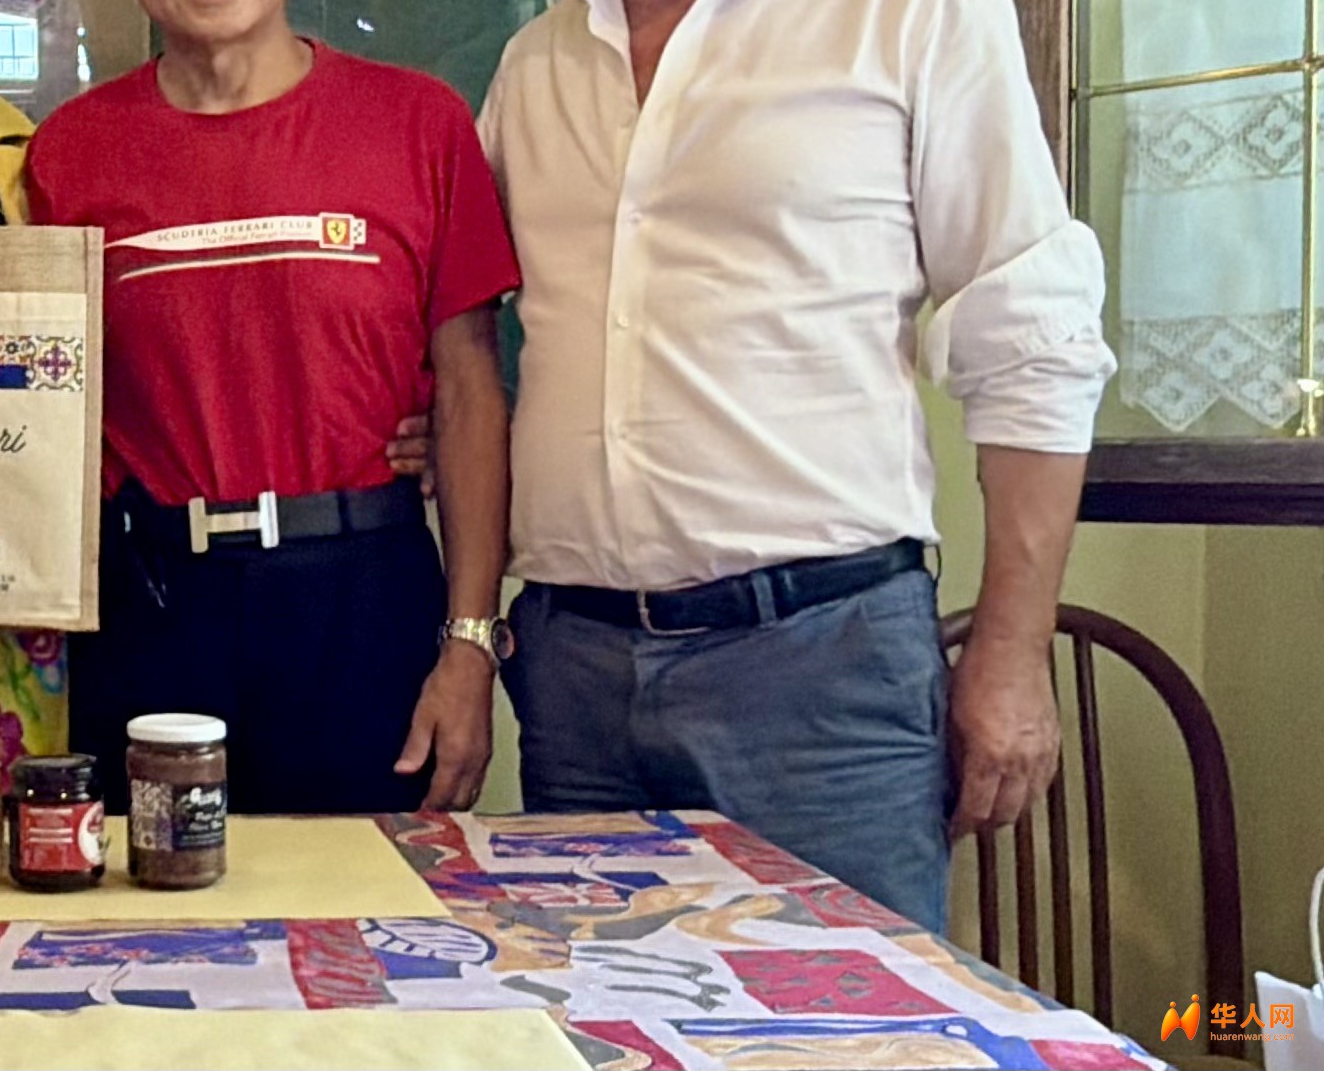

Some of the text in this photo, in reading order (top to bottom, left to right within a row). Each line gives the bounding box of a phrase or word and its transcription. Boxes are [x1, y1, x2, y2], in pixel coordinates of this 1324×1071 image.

[156, 227, 218, 242] SCUDERIA
[223, 221, 275, 234] FERRARI
[280, 219, 313, 229] CLUB
